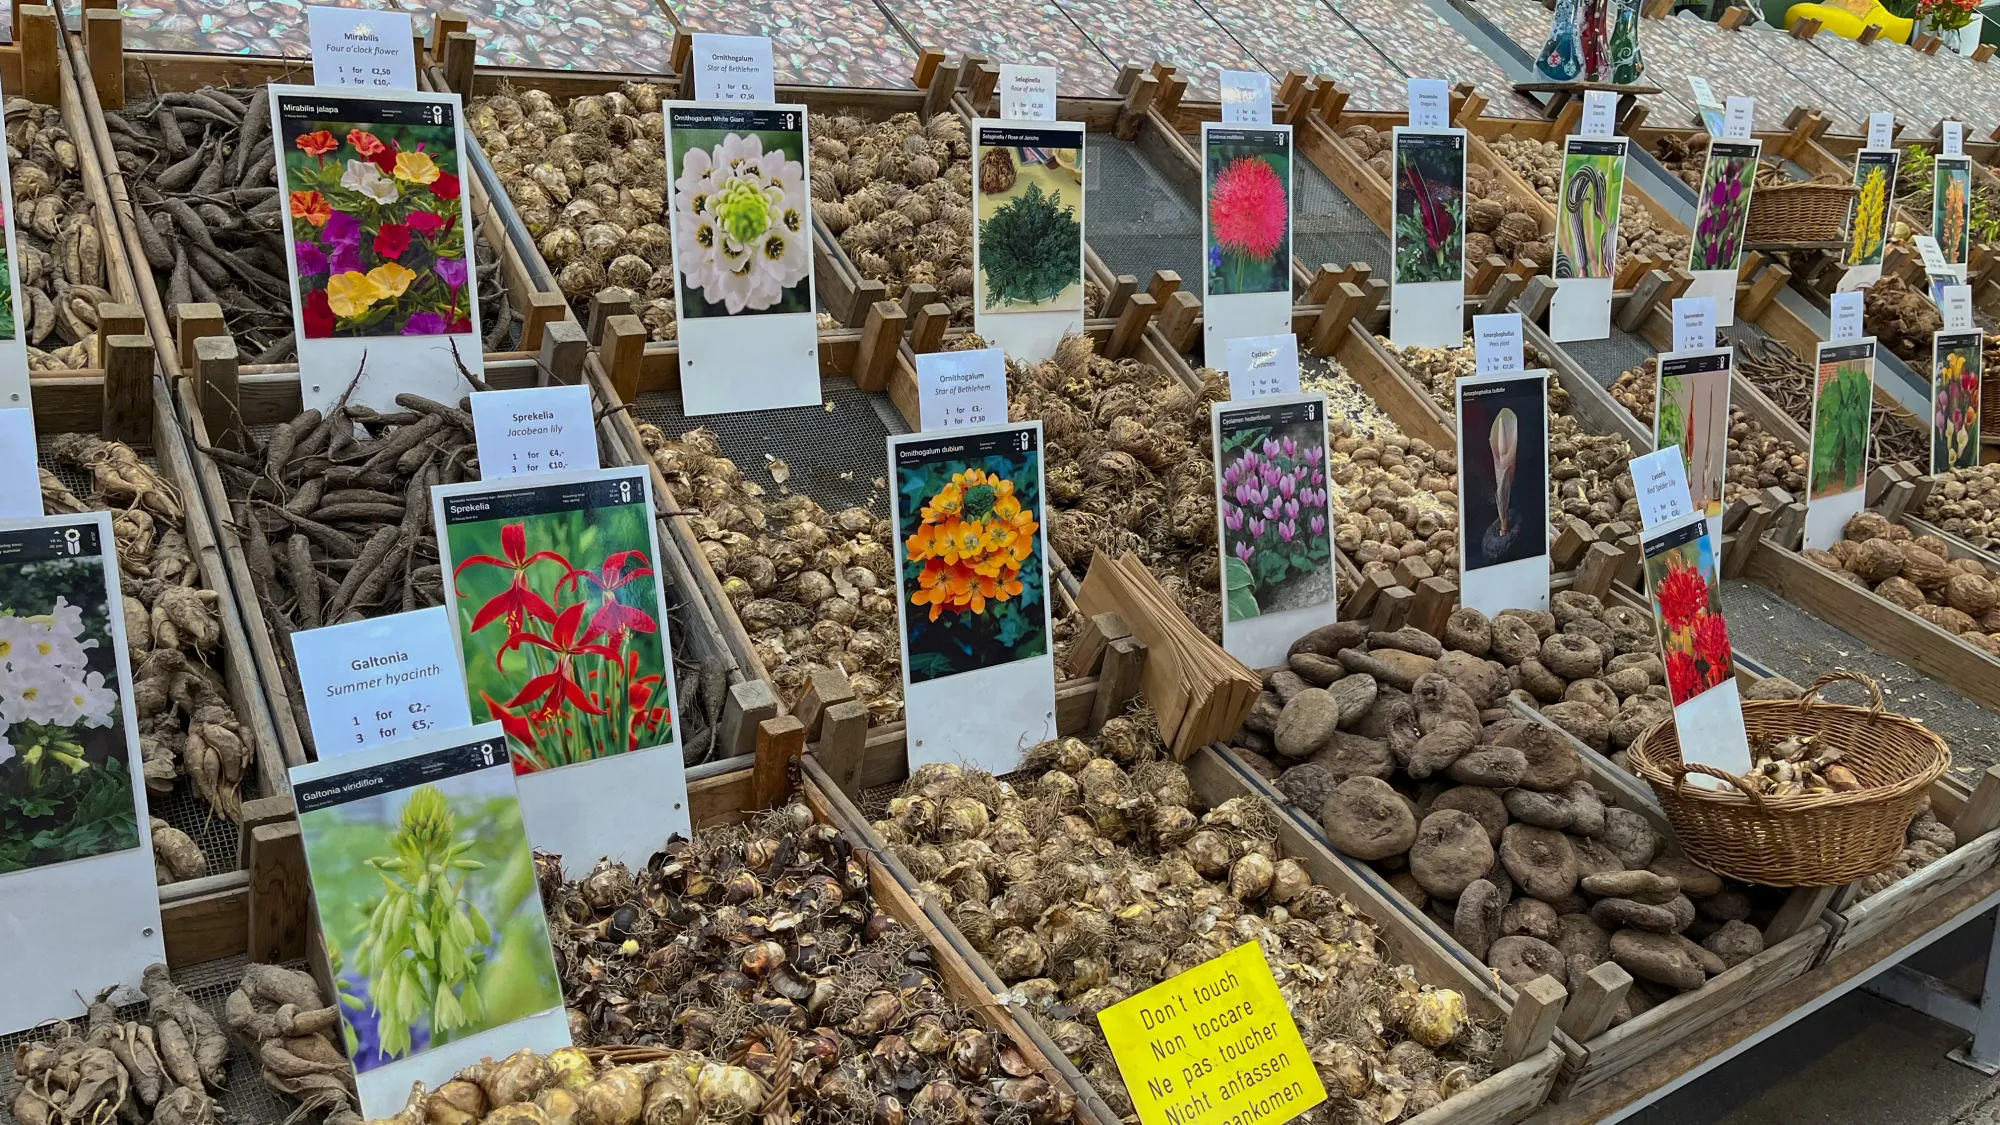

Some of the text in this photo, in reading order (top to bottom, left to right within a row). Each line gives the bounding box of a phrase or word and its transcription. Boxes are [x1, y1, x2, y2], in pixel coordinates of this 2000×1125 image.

[344, 32, 379, 42] Mirabilis
[326, 44, 344, 52] Four
[374, 46, 400, 56] flower
[712, 54, 754, 64] Ornithogalum
[284, 104, 338, 114] Mirabilis jalapa
[674, 114, 711, 123] Ornithogalum
[940, 373, 985, 383] Ornithogalum
[949, 387, 956, 396] of
[958, 384, 990, 394] Bethlehem
[512, 412, 554, 423] Sprekelia
[970, 416, 985, 424] €7,50
[507, 425, 563, 436] Jacobean lily
[549, 449, 564, 458] €4,-
[900, 445, 964, 459] Ornithogalum dubium
[549, 461, 568, 471] €10,-
[450, 503, 490, 514] Sprekelia
[351, 651, 409, 671] Galtonia
[326, 664, 440, 697] Summer hyacinth
[352, 702, 430, 726] 1 for €2,-
[356, 719, 434, 744] 3 for €5,-
[302, 776, 384, 802] Galtonia viridiflora
[1140, 970, 1240, 1030] Don't touch
[1150, 1000, 1254, 1062] Non toccare
[1147, 1022, 1279, 1101] Ne pas toucher
[1164, 1052, 1290, 1125] Nicht anfassen
